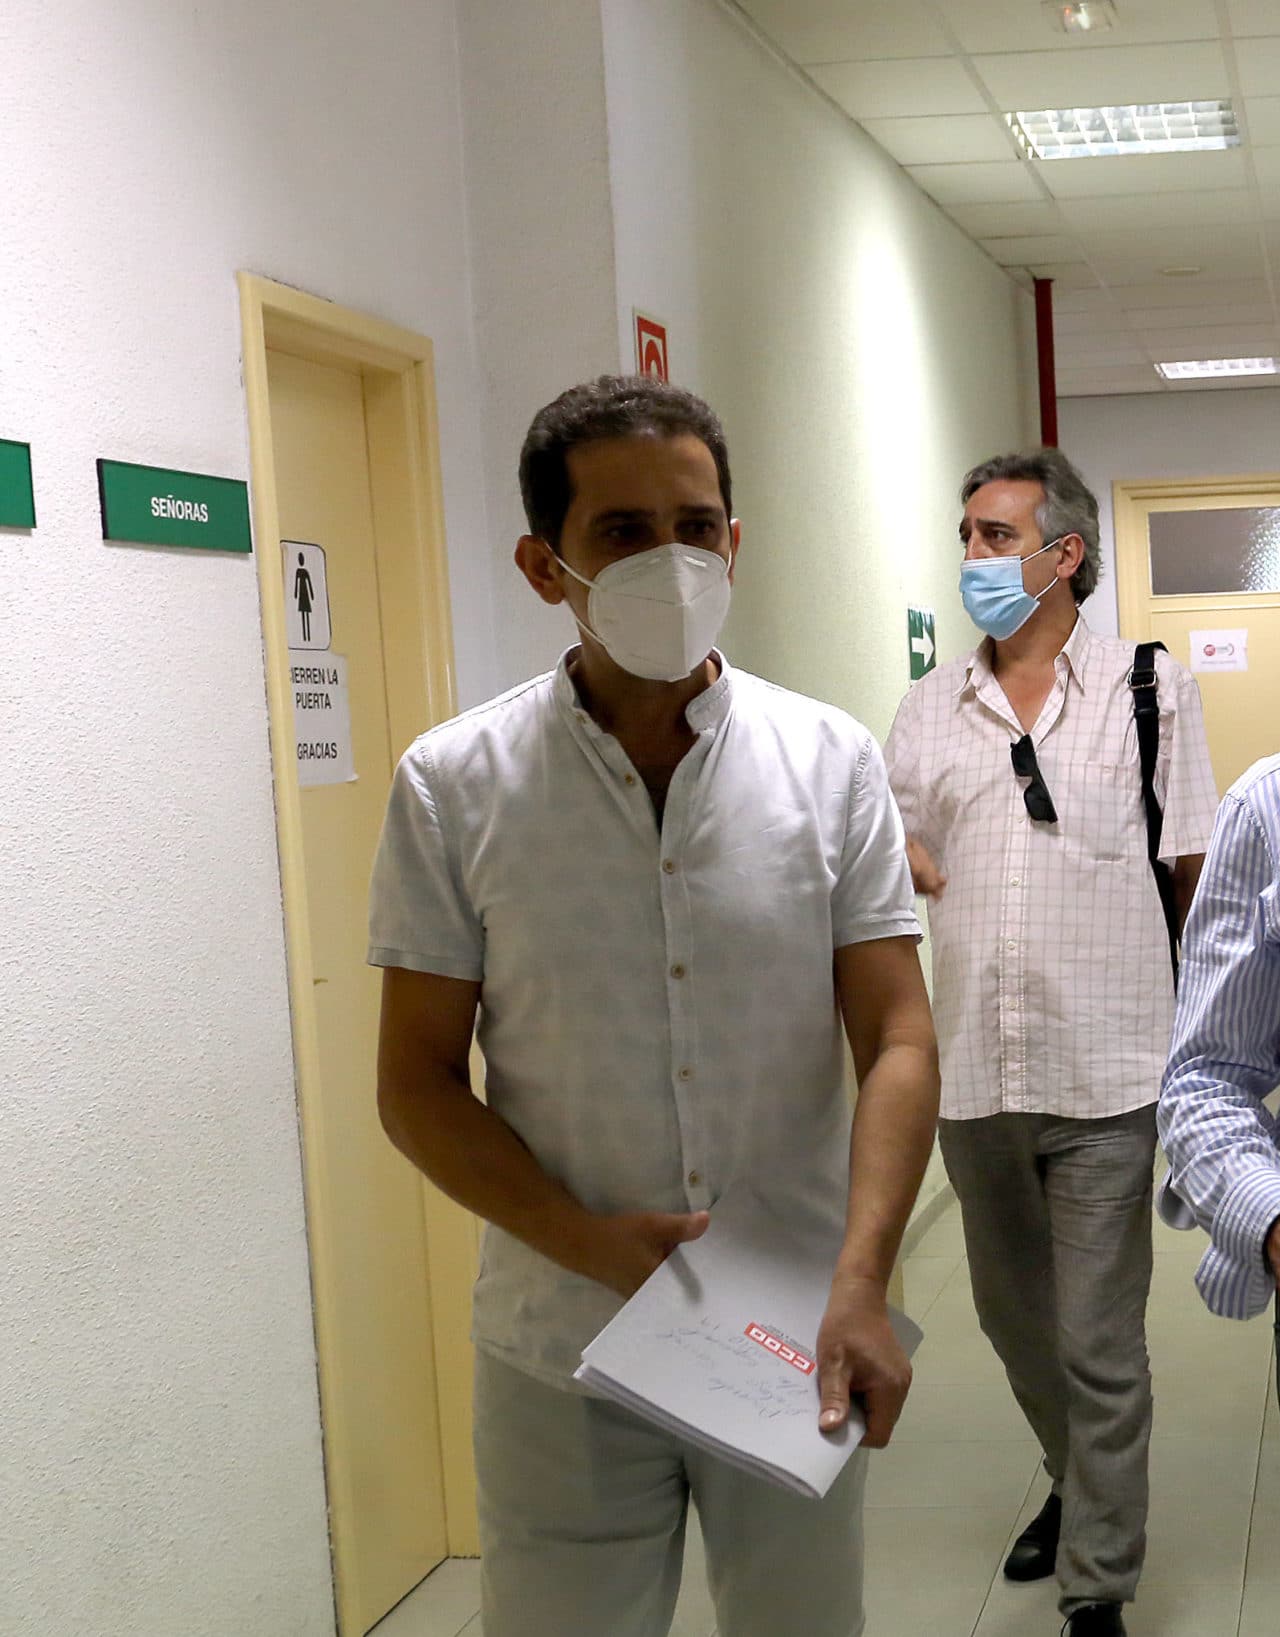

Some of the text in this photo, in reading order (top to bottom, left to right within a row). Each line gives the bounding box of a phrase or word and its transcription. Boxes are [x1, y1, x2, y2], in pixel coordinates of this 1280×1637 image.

[151, 494, 209, 522] SEÑORAS
[290, 667, 338, 685] IERREN LA
[295, 692, 332, 709] PUERTA
[297, 742, 337, 760] GRACIAS
[749, 1327, 811, 1370] CCOO
